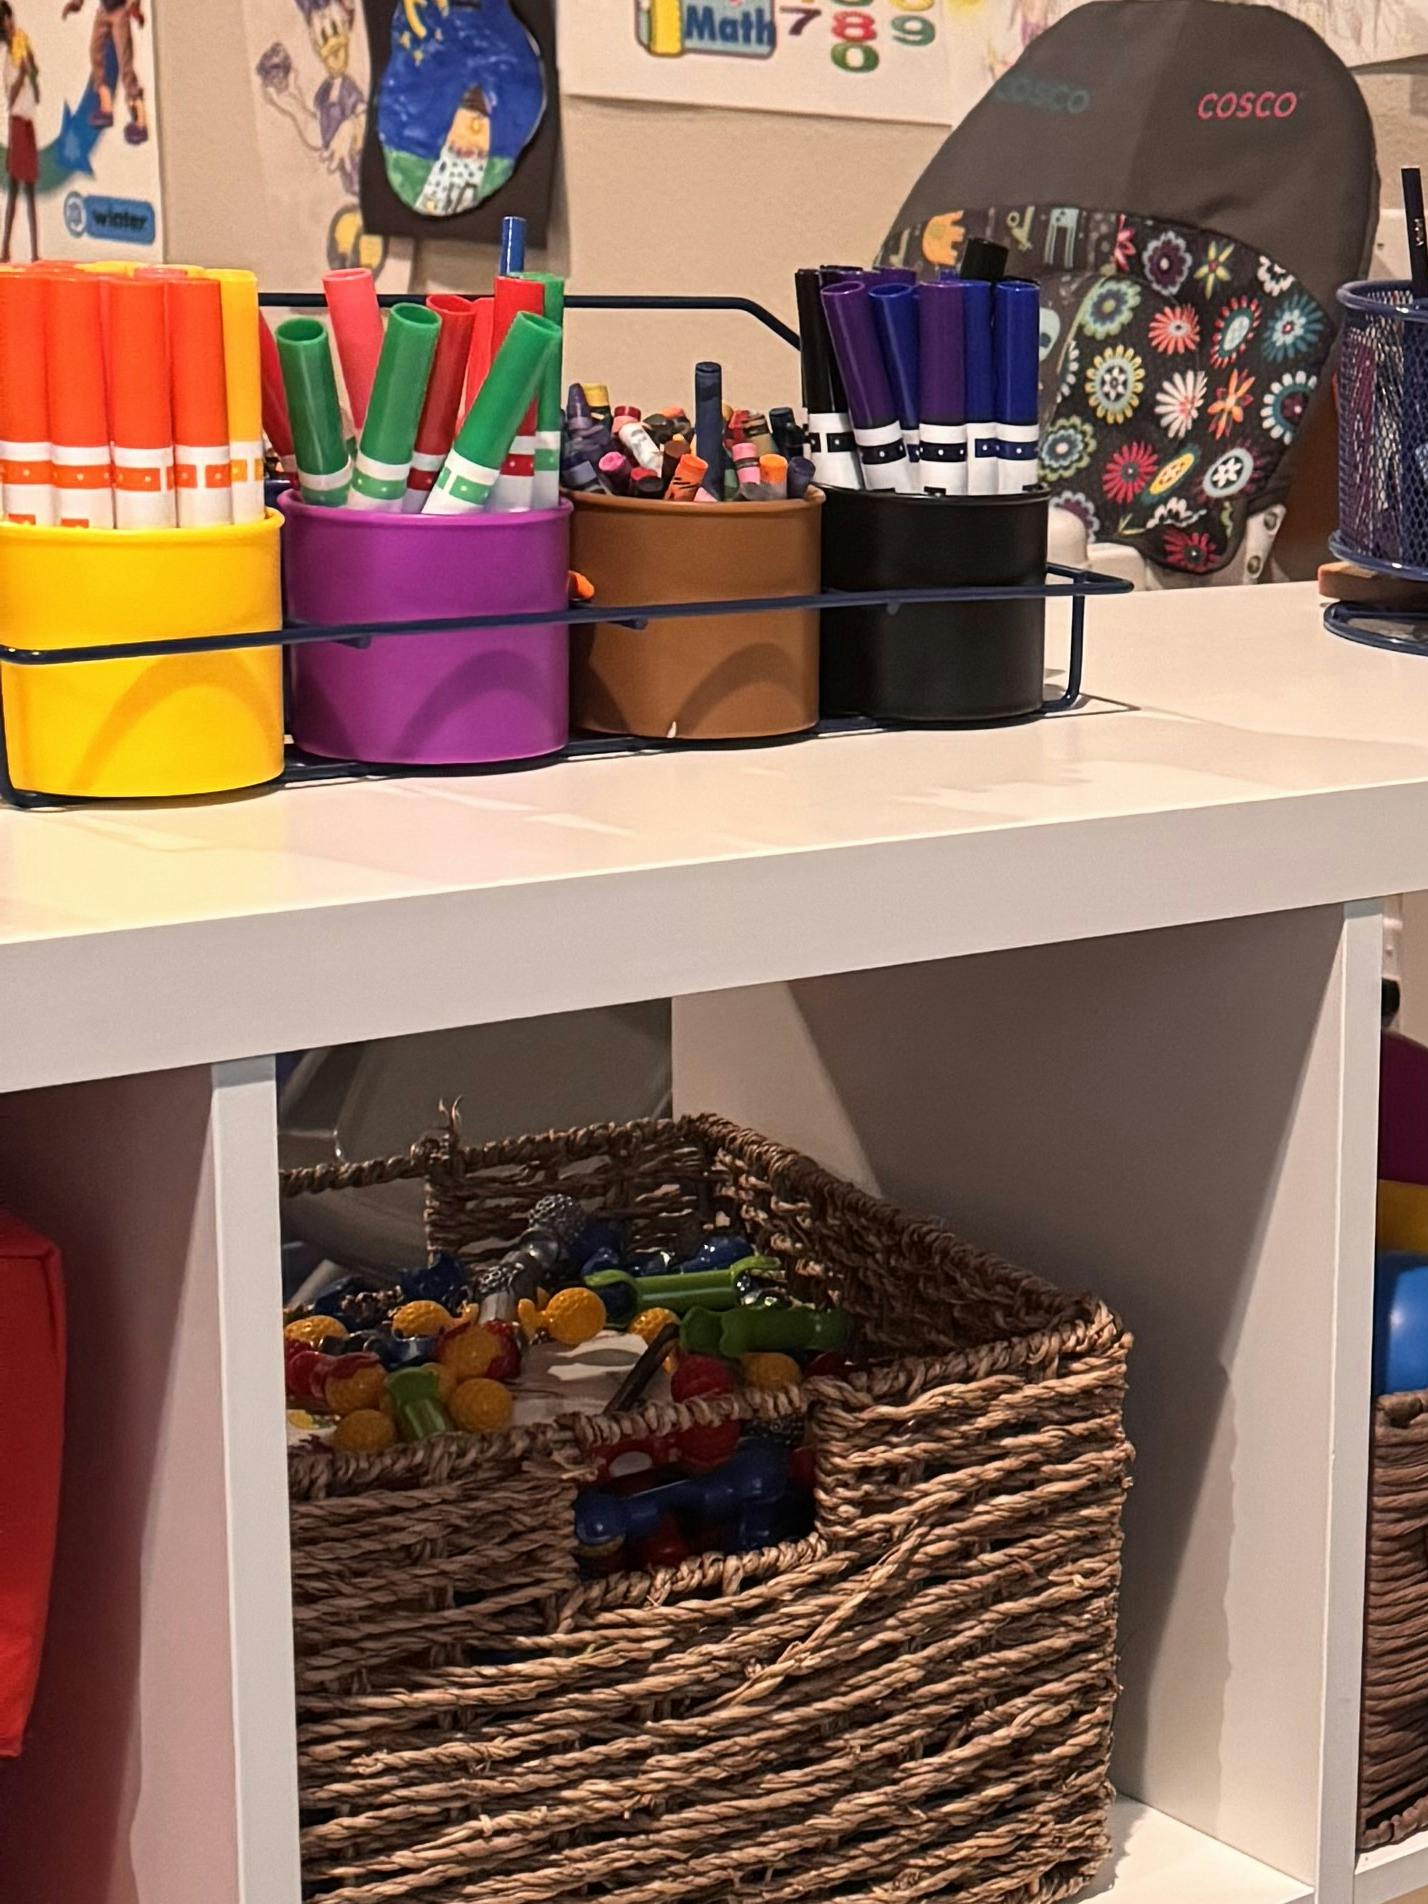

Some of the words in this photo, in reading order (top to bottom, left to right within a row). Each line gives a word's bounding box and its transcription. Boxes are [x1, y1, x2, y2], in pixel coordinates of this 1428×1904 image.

[684, 4, 777, 47] Math
[778, 5, 823, 37] 7
[830, 10, 879, 43] 8
[890, 13, 938, 47] 9
[829, 42, 881, 75] 0
[1197, 91, 1298, 120] COSCO
